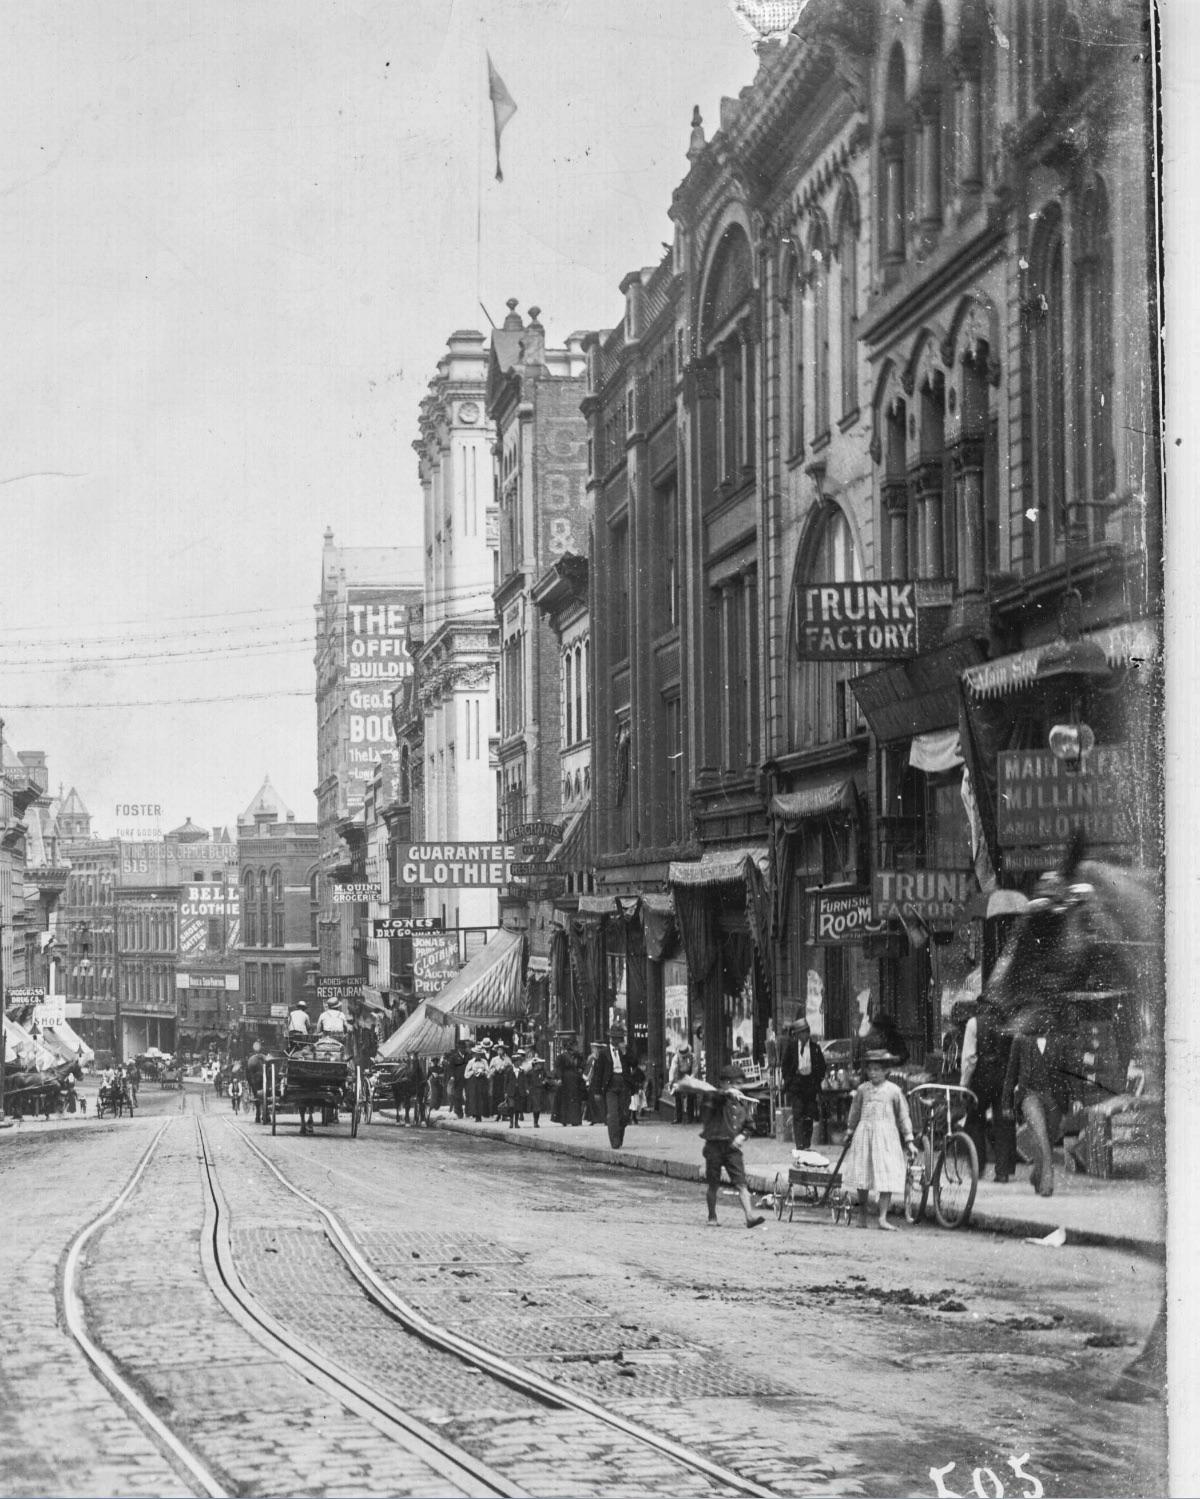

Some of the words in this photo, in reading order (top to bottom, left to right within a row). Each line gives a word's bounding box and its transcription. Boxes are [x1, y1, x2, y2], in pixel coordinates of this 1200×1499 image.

[805, 584, 915, 622] TRUNK
[348, 604, 405, 635] THE
[351, 639, 410, 657] OFFIC
[349, 661, 414, 677] BUILDIN
[115, 804, 162, 816] FOSTER
[408, 845, 516, 860] GUARANTEE
[123, 859, 148, 873] 515
[188, 887, 240, 901] BELL
[180, 903, 240, 915] CLOTHIE
[820, 897, 870, 914] FURNISHE
[381, 919, 433, 928] JONES
[375, 929, 395, 937] DRY
